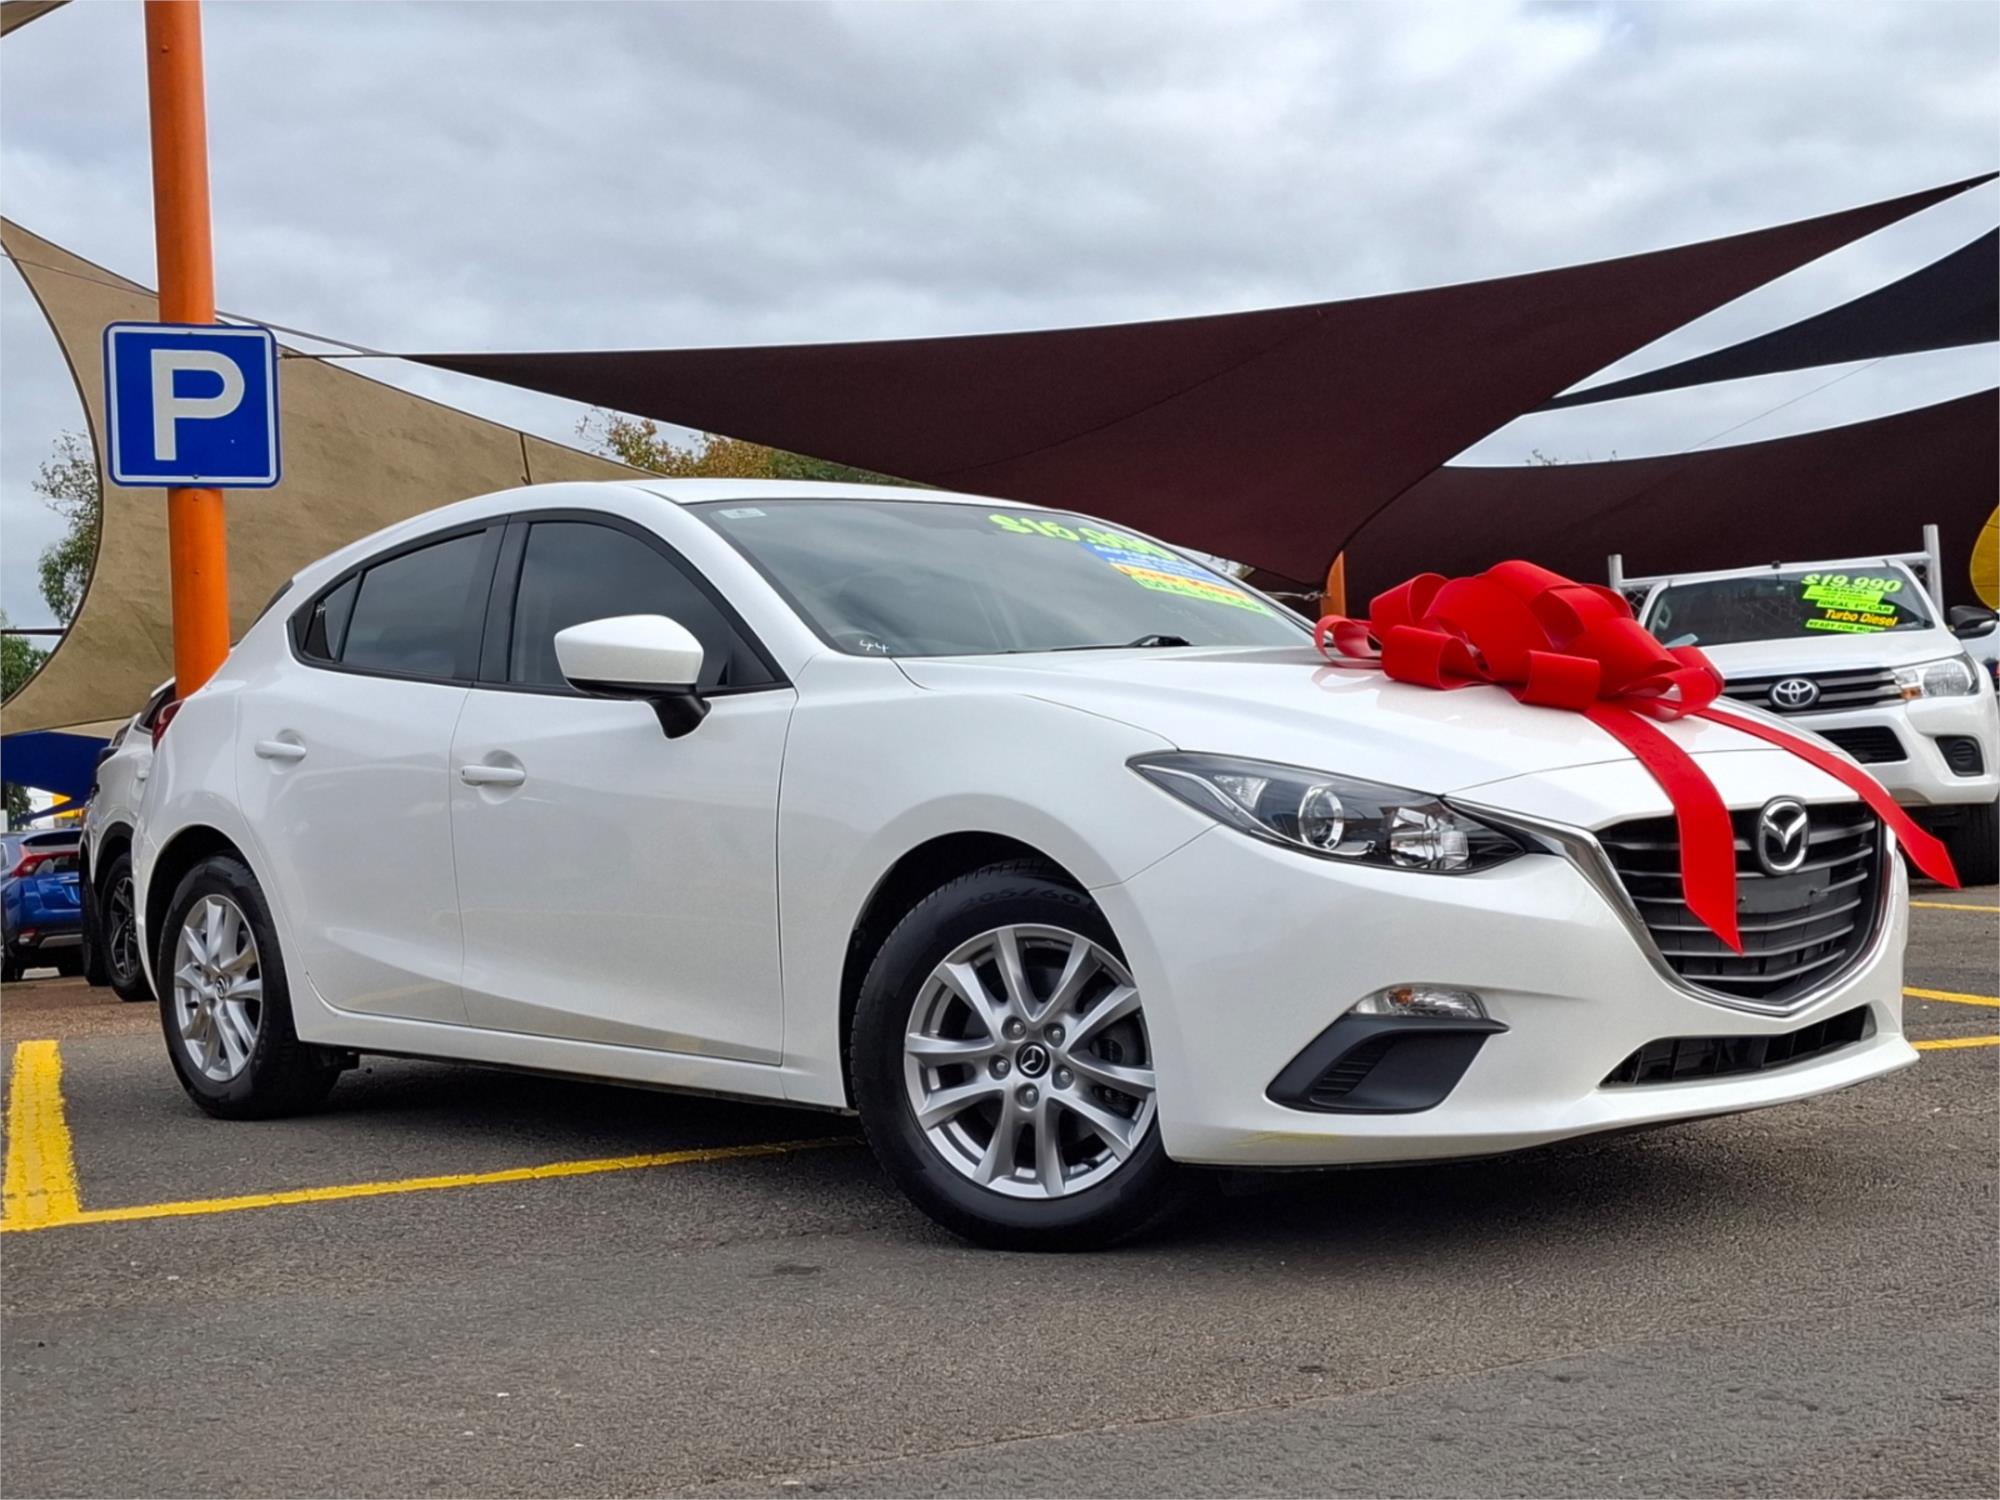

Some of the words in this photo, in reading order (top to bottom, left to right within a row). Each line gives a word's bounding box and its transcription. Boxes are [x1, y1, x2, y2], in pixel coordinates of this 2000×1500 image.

[151, 349, 245, 460] P
[1801, 573, 1902, 592] $19.990
[1825, 608, 1858, 621] Turbo
[1859, 612, 1898, 627] Diesel
[1868, 604, 1893, 612] CAR
